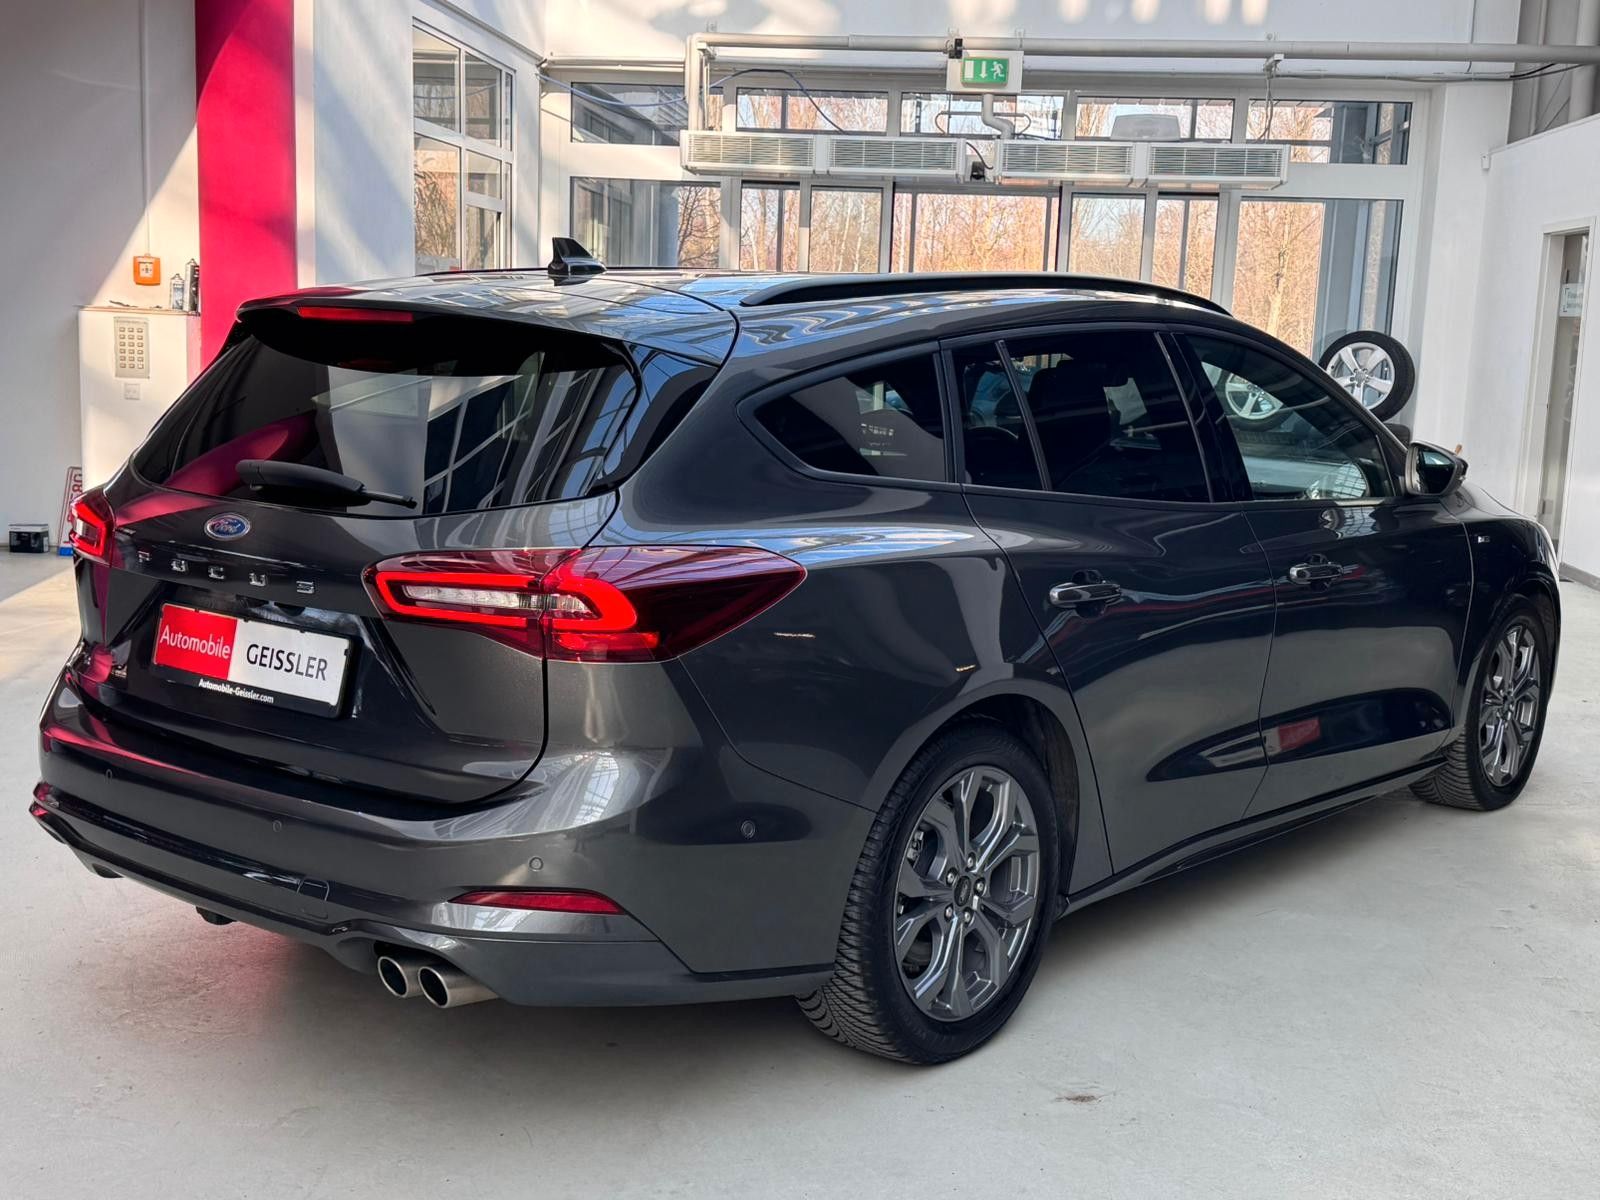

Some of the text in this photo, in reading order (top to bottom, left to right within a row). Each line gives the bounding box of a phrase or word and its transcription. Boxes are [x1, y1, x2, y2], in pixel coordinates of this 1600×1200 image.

[160, 625, 329, 681] Automobile GEISSLER
[198, 678, 274, 704] Automobile-Geissler.com
